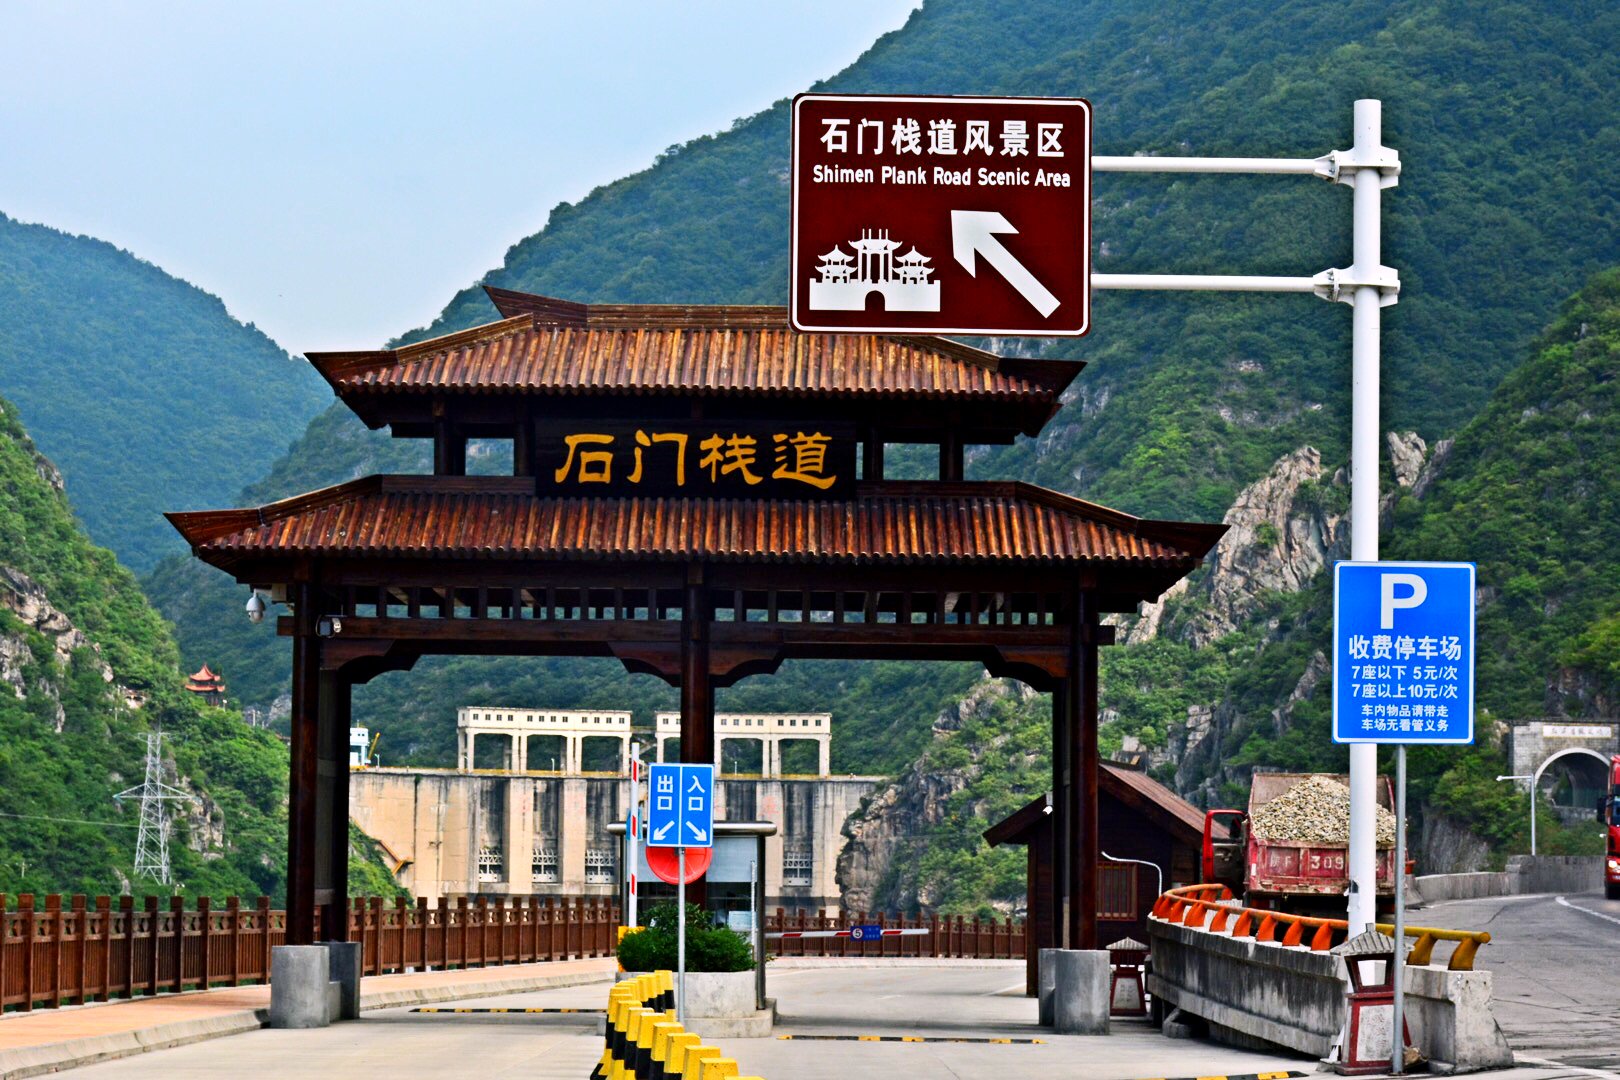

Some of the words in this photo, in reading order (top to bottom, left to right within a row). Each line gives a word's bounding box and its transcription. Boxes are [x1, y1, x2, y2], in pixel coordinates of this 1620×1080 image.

[820, 118, 1064, 157] 石门栈道风景区
[813, 164, 873, 182] Shimen
[882, 166, 926, 184] Plank
[934, 167, 971, 185] Road
[978, 168, 1029, 185] Scenic
[1035, 169, 1070, 187] Area
[556, 430, 835, 489] 石门栈道
[1381, 574, 1427, 629] P
[1349, 635, 1461, 660] 收费停车场
[1352, 665, 1406, 679] 7座以下
[1414, 666, 1457, 680] 5元/次
[1352, 683, 1457, 698] 7座以上10元/次
[1362, 704, 1448, 717] 车内物品请带走
[1362, 719, 1448, 731] 车场无看管义务
[658, 775, 673, 810] 出口
[688, 776, 705, 811] 入口
[1311, 855, 1344, 870] 309
